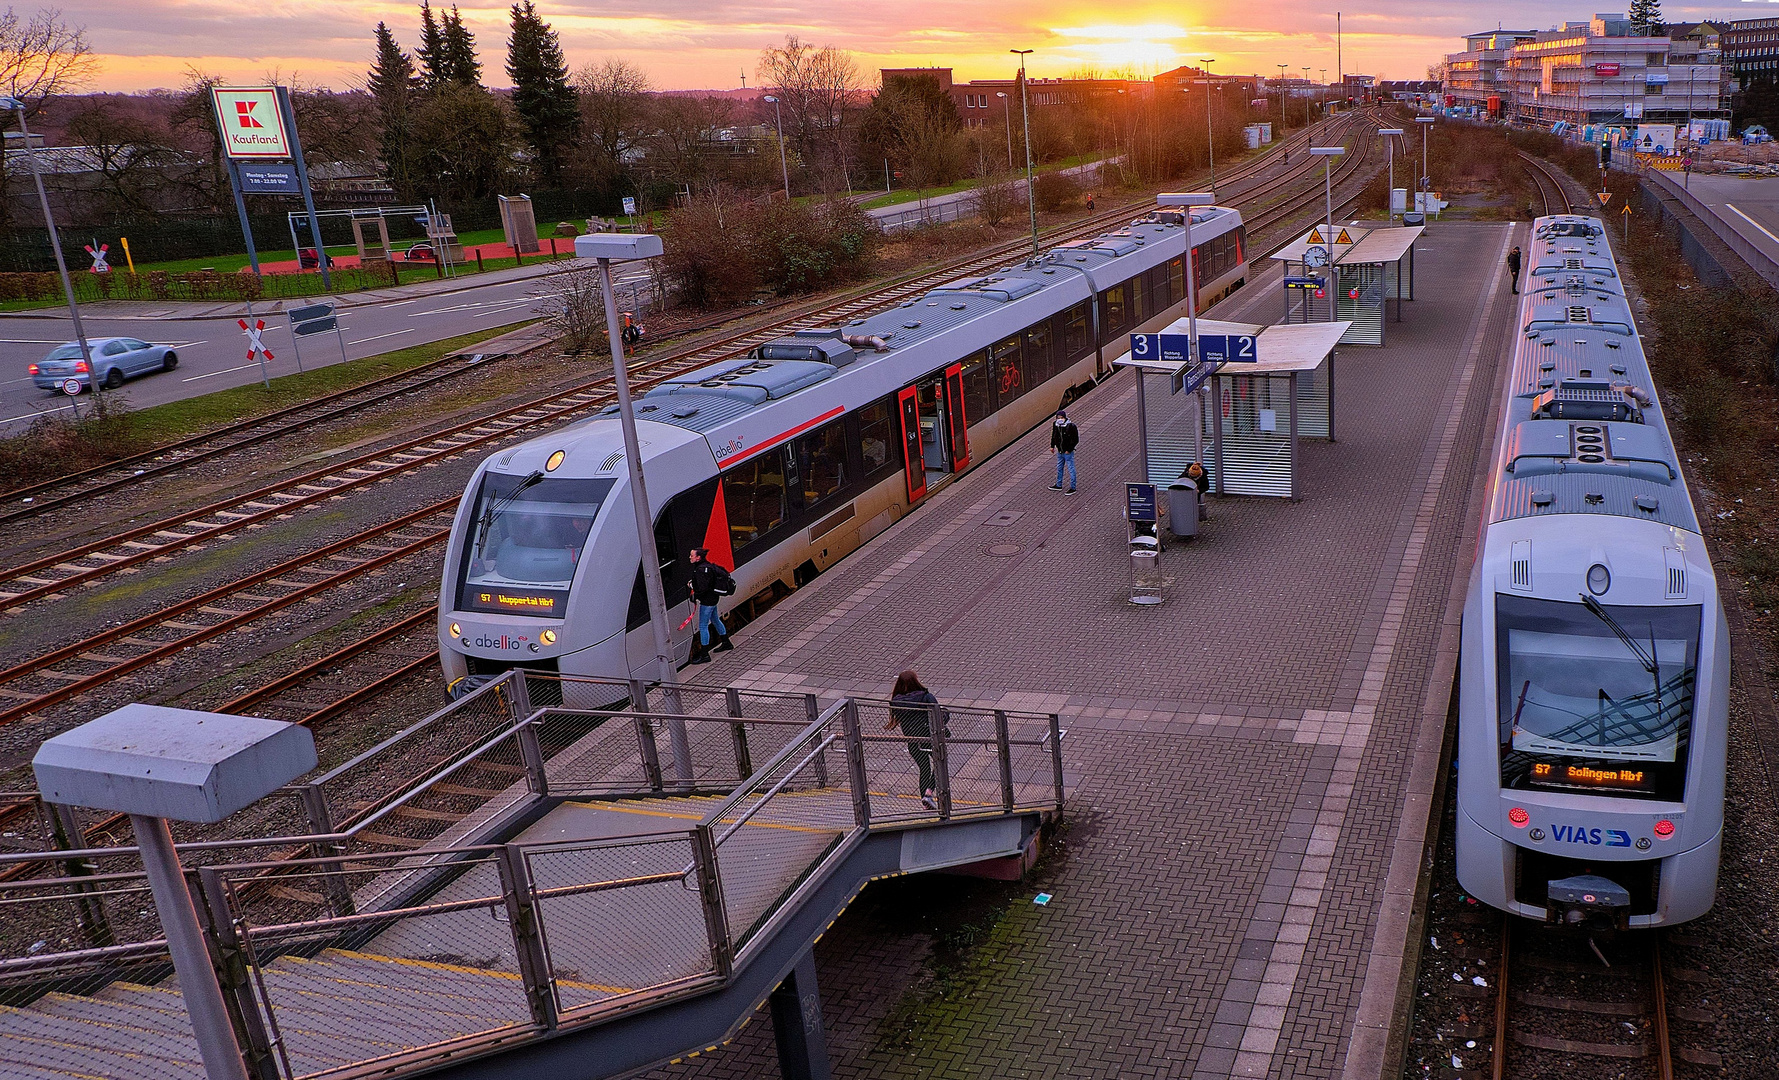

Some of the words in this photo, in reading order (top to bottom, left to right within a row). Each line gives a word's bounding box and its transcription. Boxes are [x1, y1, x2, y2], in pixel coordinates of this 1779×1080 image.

[232, 134, 279, 144] Kaufland
[1134, 334, 1149, 355] 3
[1238, 336, 1253, 357] 2
[716, 440, 743, 458] abellio
[786, 443, 793, 460] 1
[480, 593, 491, 602] S7
[498, 594, 538, 606] Wuppertal
[538, 597, 554, 607] Hbf
[475, 634, 520, 650] abellio
[1535, 763, 1551, 774] S7
[1568, 766, 1617, 781] Solingen
[1620, 769, 1643, 781] Hbf
[1550, 824, 1602, 846] VIAS
